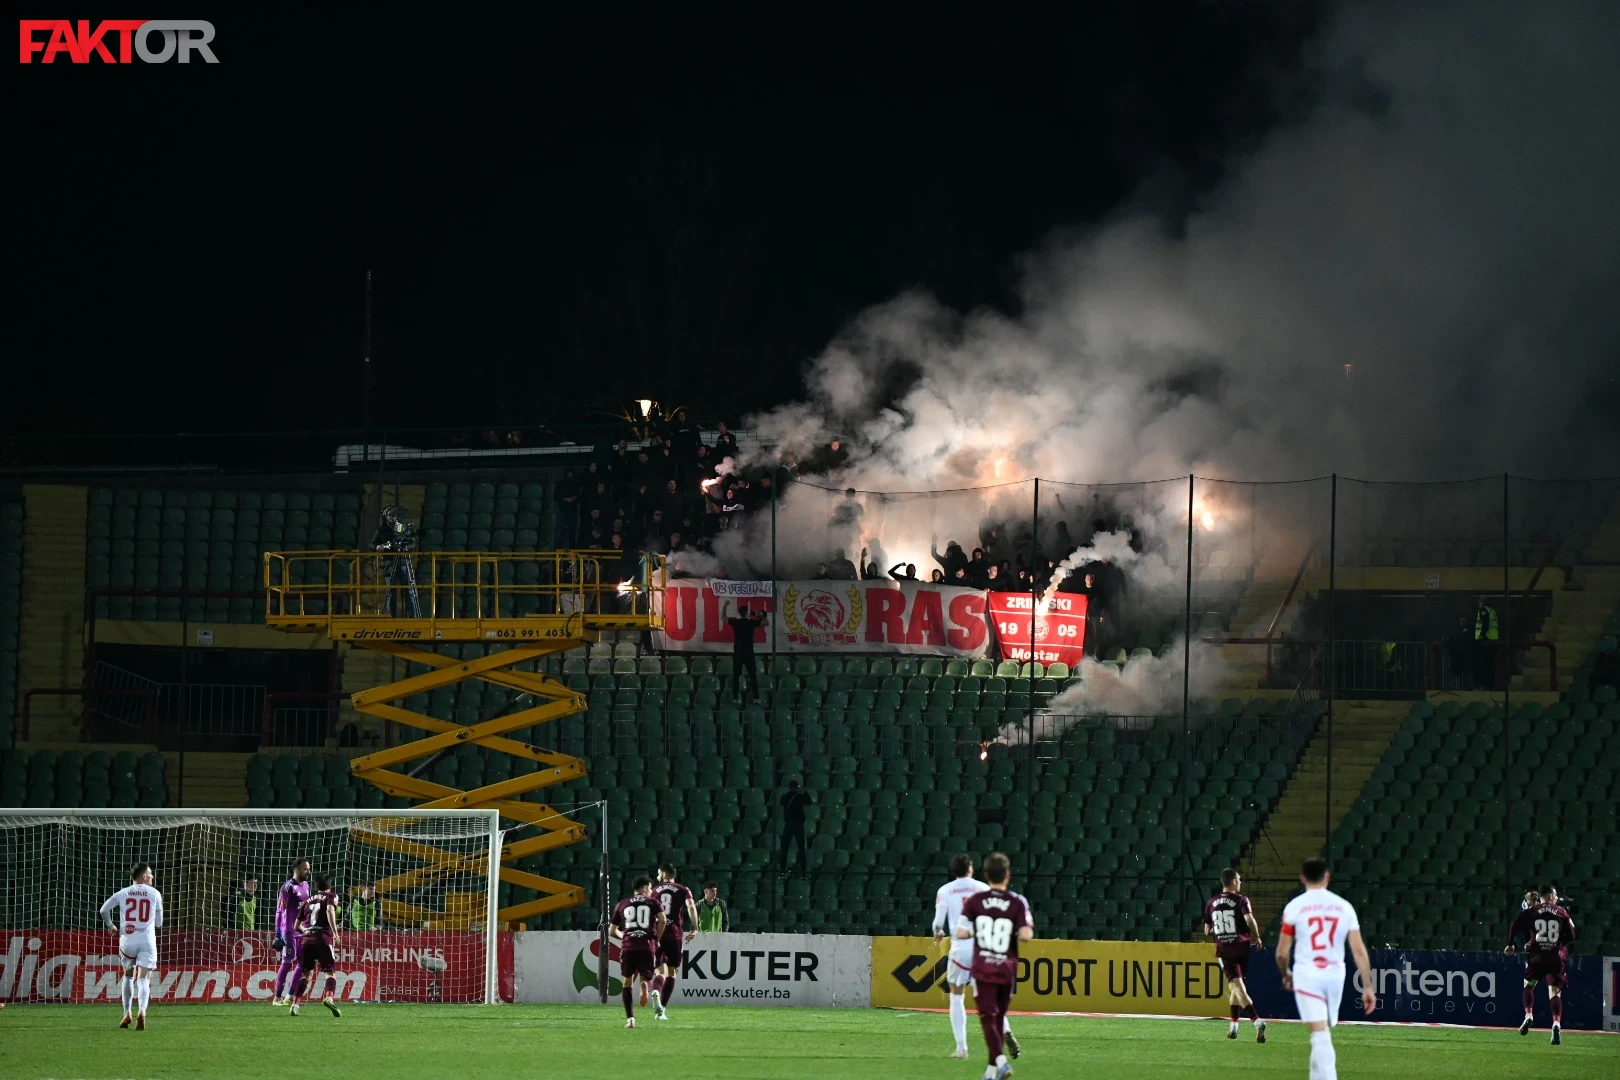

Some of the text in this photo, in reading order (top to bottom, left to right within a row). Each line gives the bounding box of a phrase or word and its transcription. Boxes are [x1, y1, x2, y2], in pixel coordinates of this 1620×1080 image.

[1006, 597, 1072, 611] ZRISKI
[353, 628, 422, 639] driveline
[496, 629, 516, 638] 062
[521, 629, 540, 638] 991
[545, 629, 565, 638] 403
[999, 622, 1077, 637] 19 05
[1011, 648, 1060, 661] Mostar
[125, 898, 151, 922] 20
[309, 903, 321, 926] 7
[624, 905, 651, 929] 20
[976, 915, 1014, 953] 88
[1308, 917, 1339, 951] 27
[1535, 919, 1560, 943] 28
[1013, 957, 1224, 999] PORT UNITED
[1353, 962, 1496, 998] antena
[682, 986, 791, 999] www.skuter.ba
[1354, 998, 1496, 1014] sarajevo
